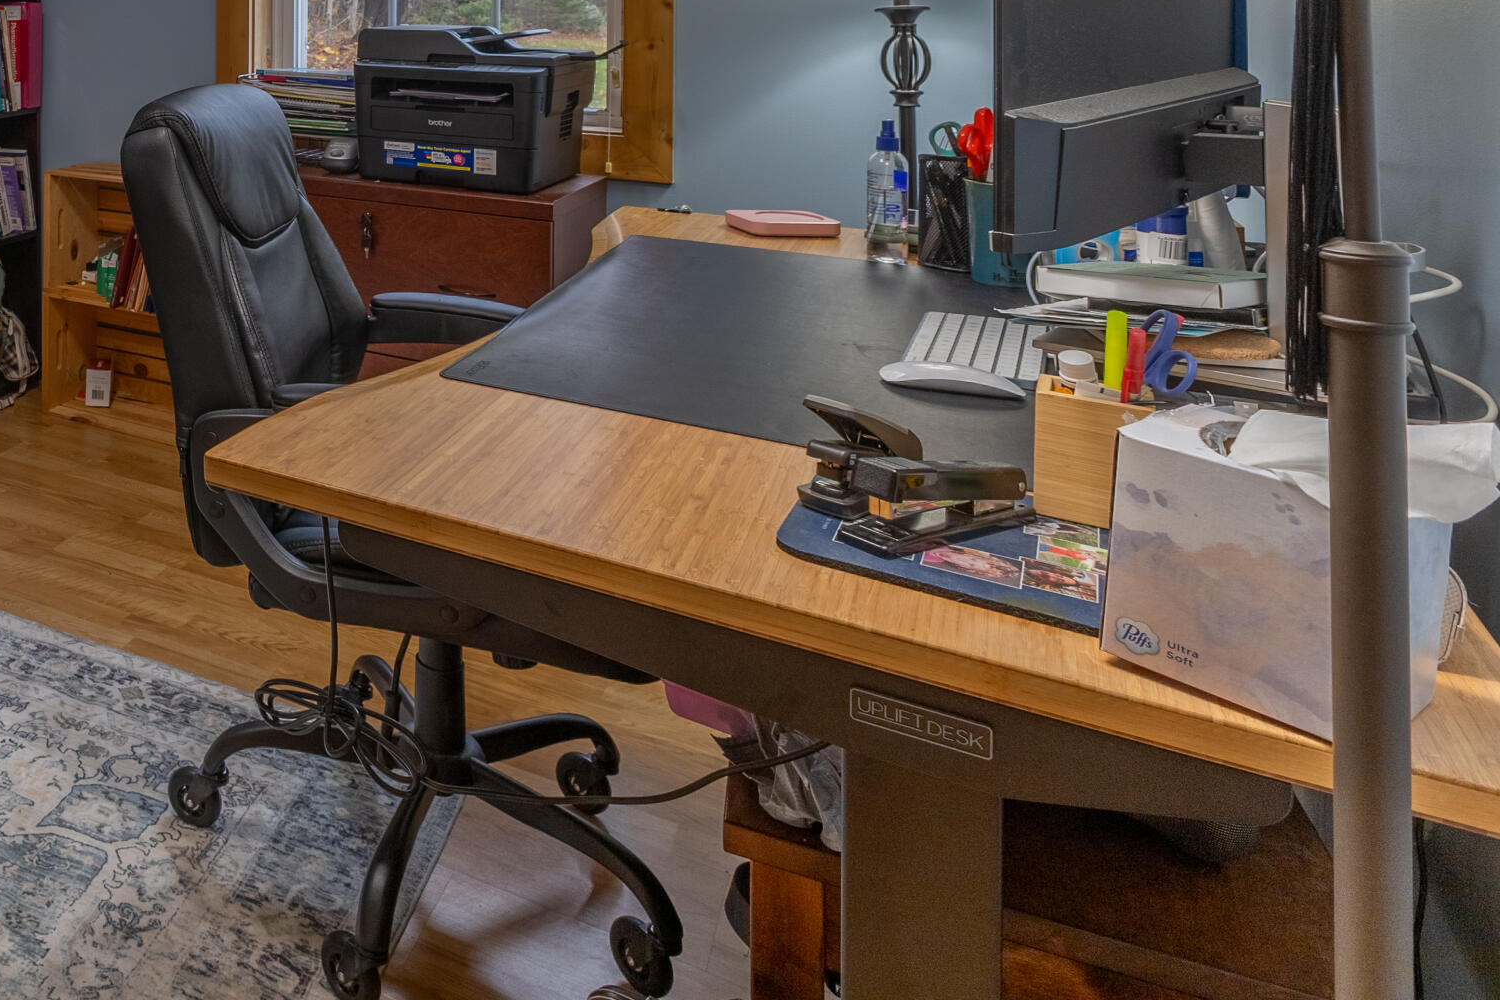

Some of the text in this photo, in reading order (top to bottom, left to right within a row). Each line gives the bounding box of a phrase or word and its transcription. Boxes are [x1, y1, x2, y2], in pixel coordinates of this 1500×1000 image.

[428, 119, 452, 127] brother
[1122, 622, 1153, 649] Puffs
[1166, 639, 1200, 660] Ultra
[1166, 650, 1194, 668] Soft
[857, 696, 985, 750] UPLIFT DESK
